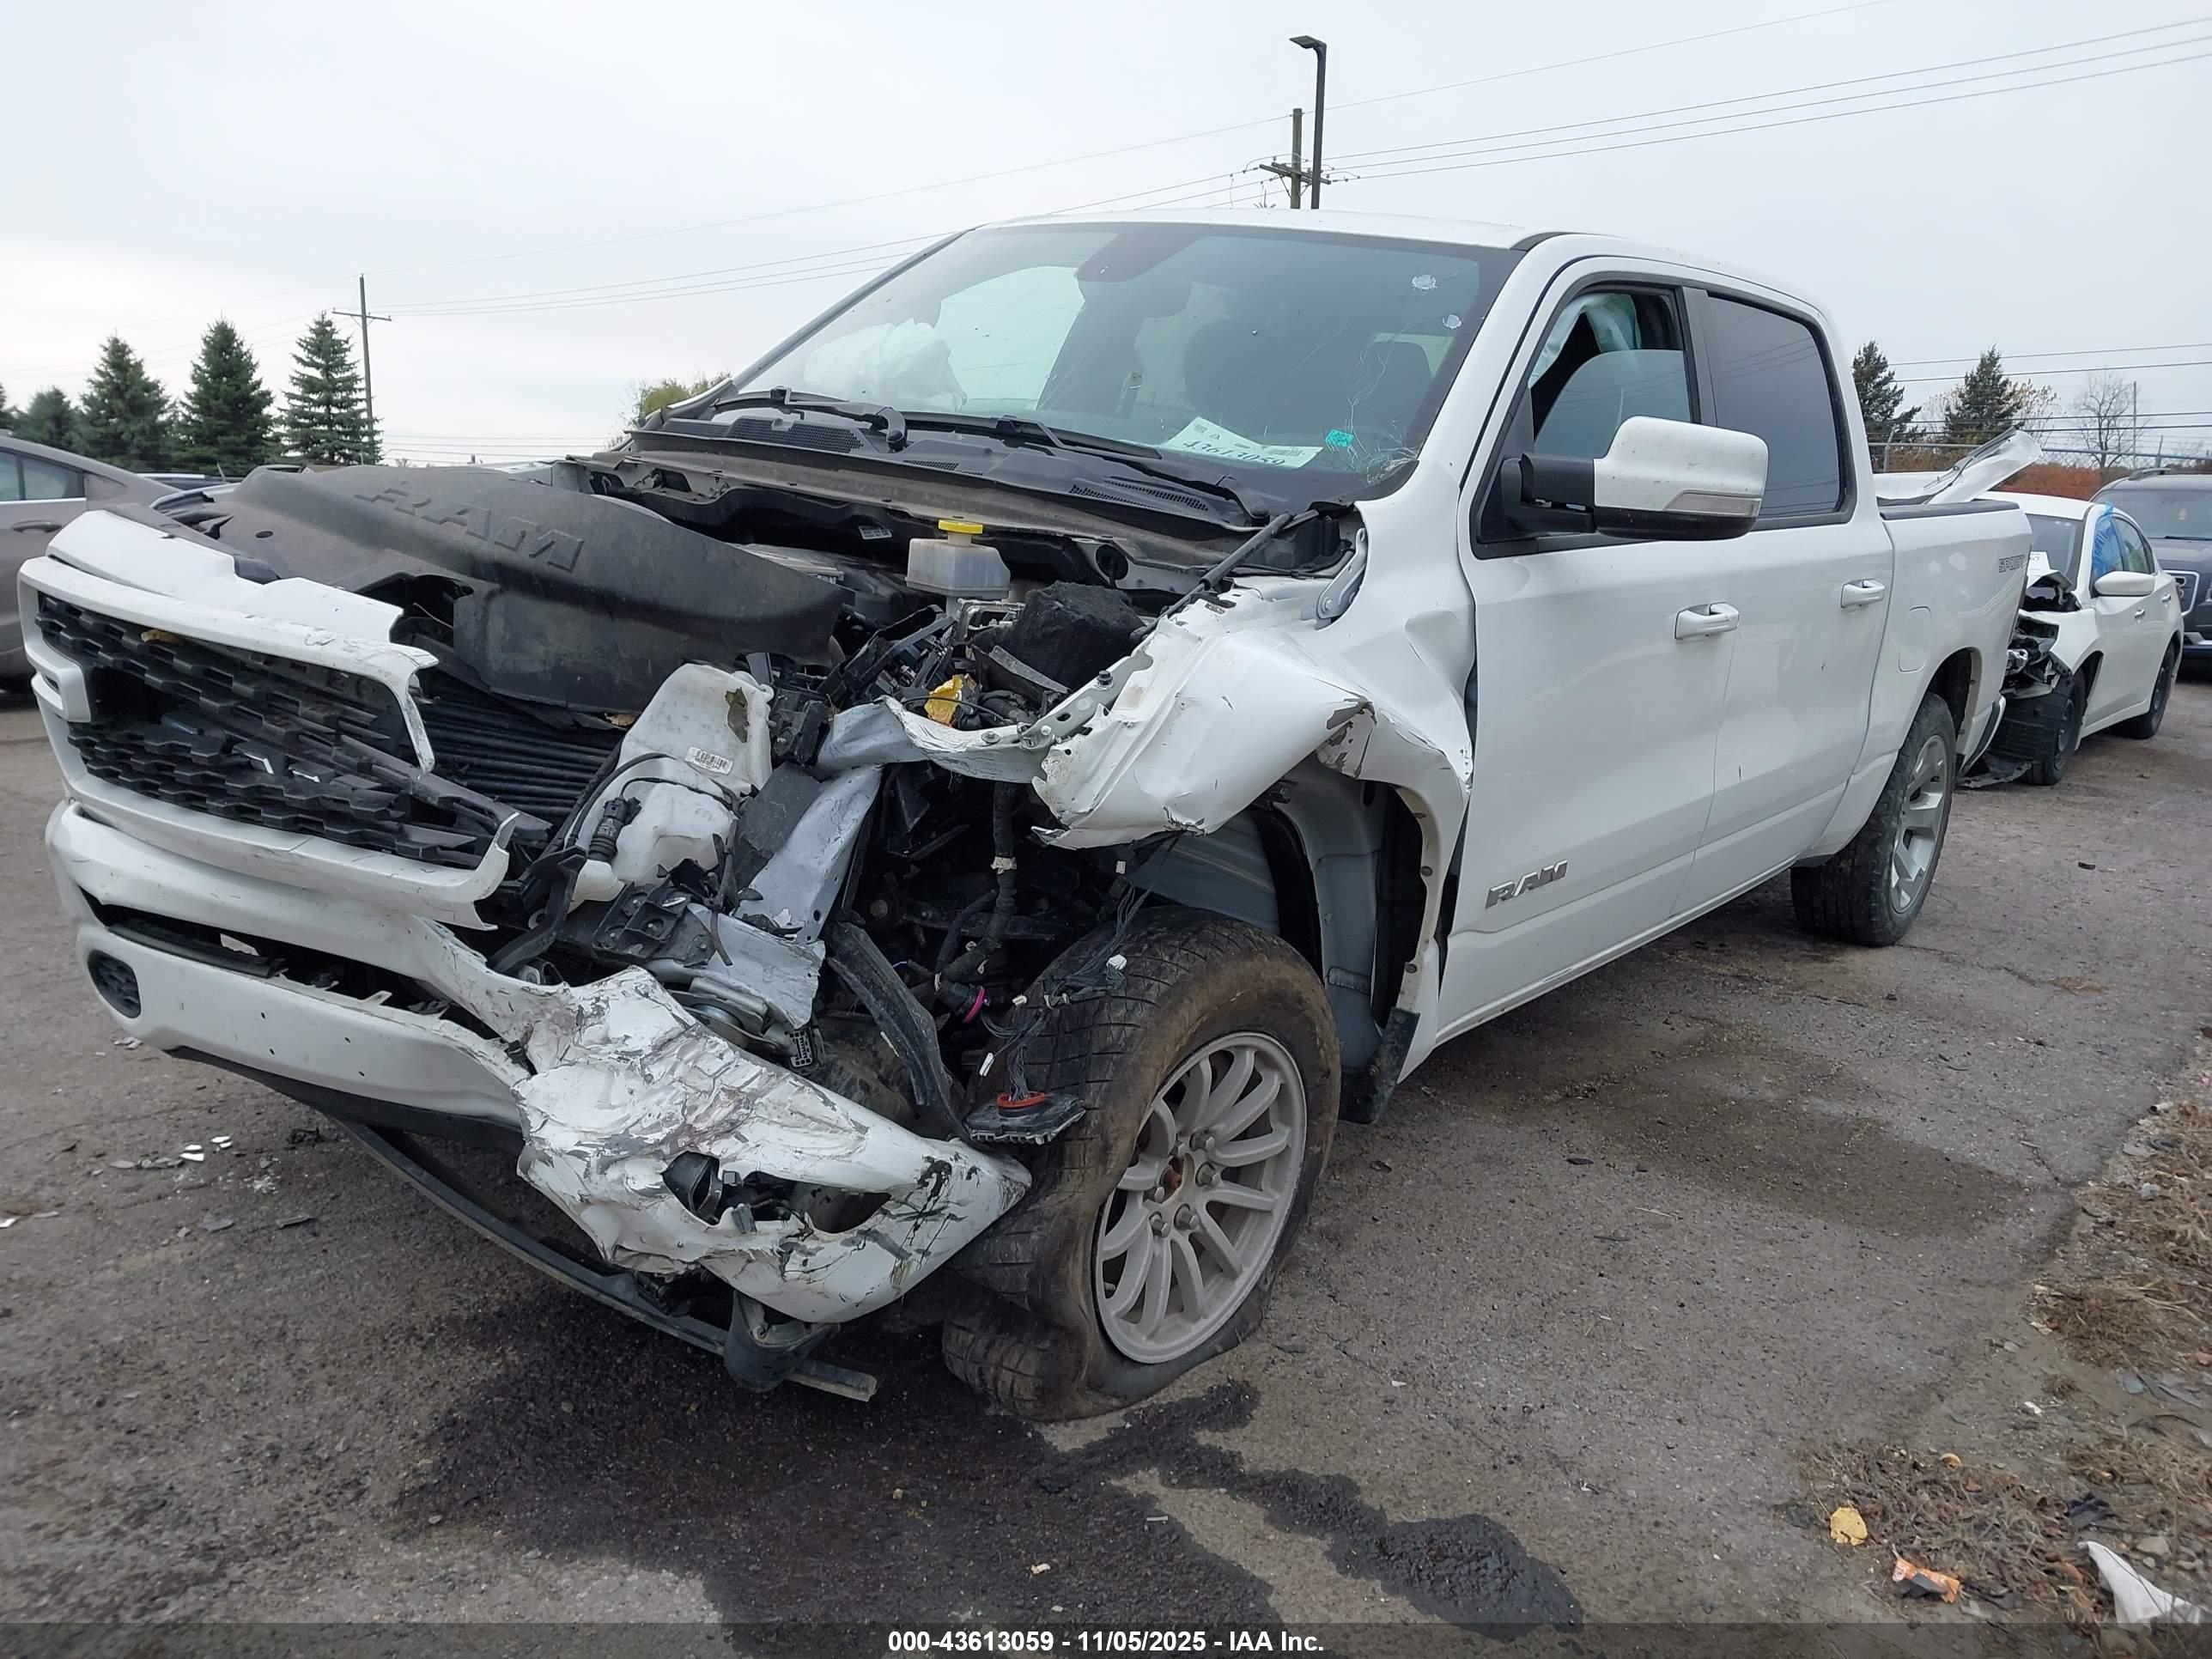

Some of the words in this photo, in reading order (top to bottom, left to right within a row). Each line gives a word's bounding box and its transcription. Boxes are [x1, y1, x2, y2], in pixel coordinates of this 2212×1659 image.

[1182, 440, 1285, 465] 43613059
[354, 483, 585, 573] RAM
[1485, 860, 1568, 909] RAM
